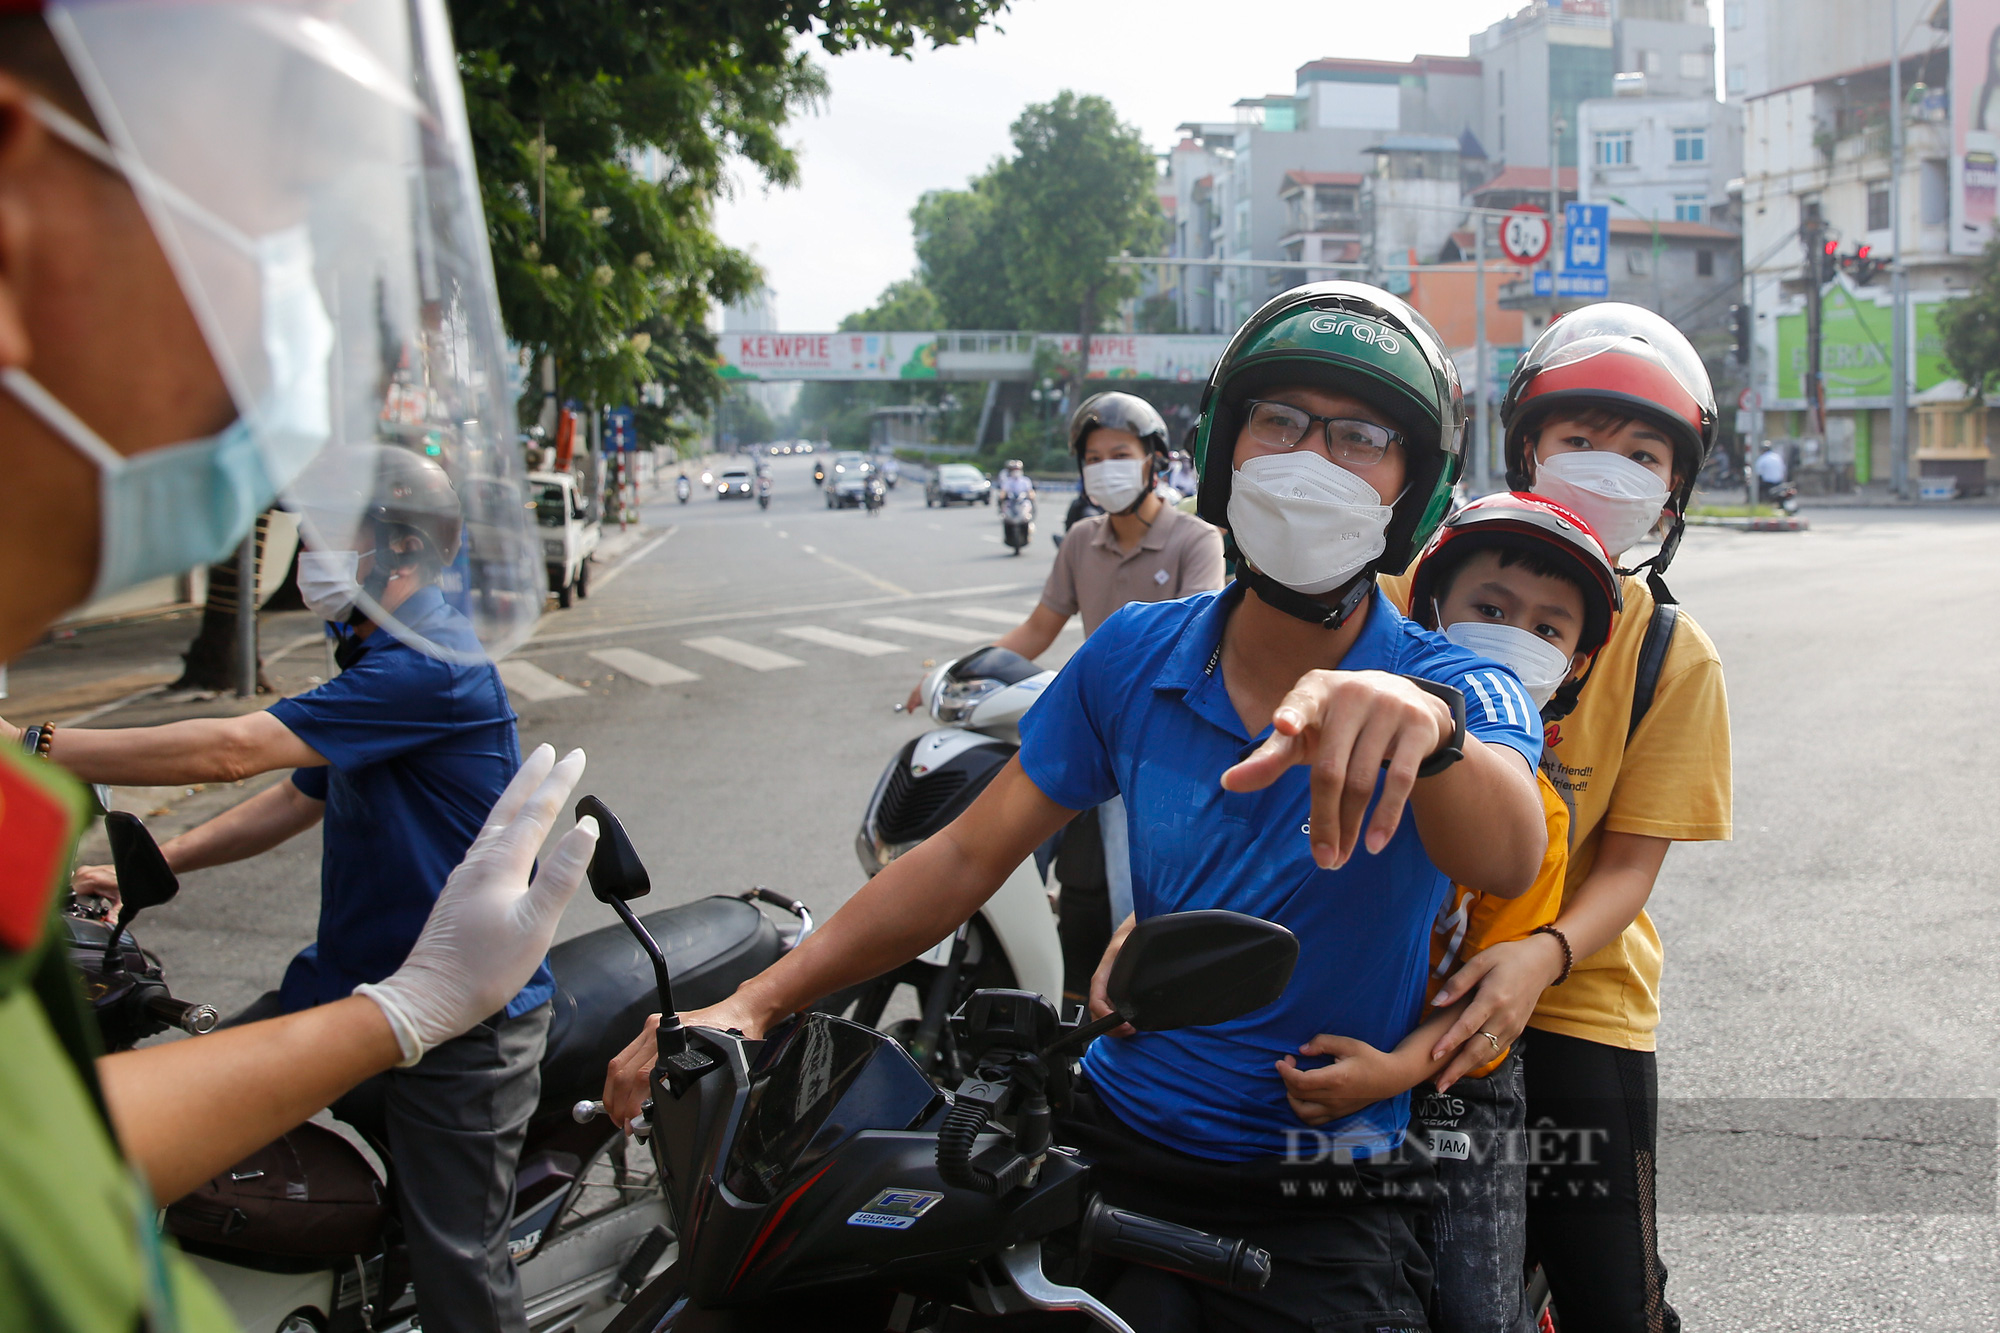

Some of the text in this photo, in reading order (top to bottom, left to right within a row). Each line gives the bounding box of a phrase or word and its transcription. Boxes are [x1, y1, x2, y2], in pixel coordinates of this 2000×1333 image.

[1309, 315, 1400, 355] Grab
[741, 337, 830, 358] KEWPIE
[1791, 342, 1888, 371] EERON
[1557, 762, 1594, 778] friend!!
[1552, 777, 1589, 793] friend!!
[1439, 1138, 1467, 1155] IAM
[877, 1192, 934, 1210] FI
[858, 1212, 898, 1222] IDLING
